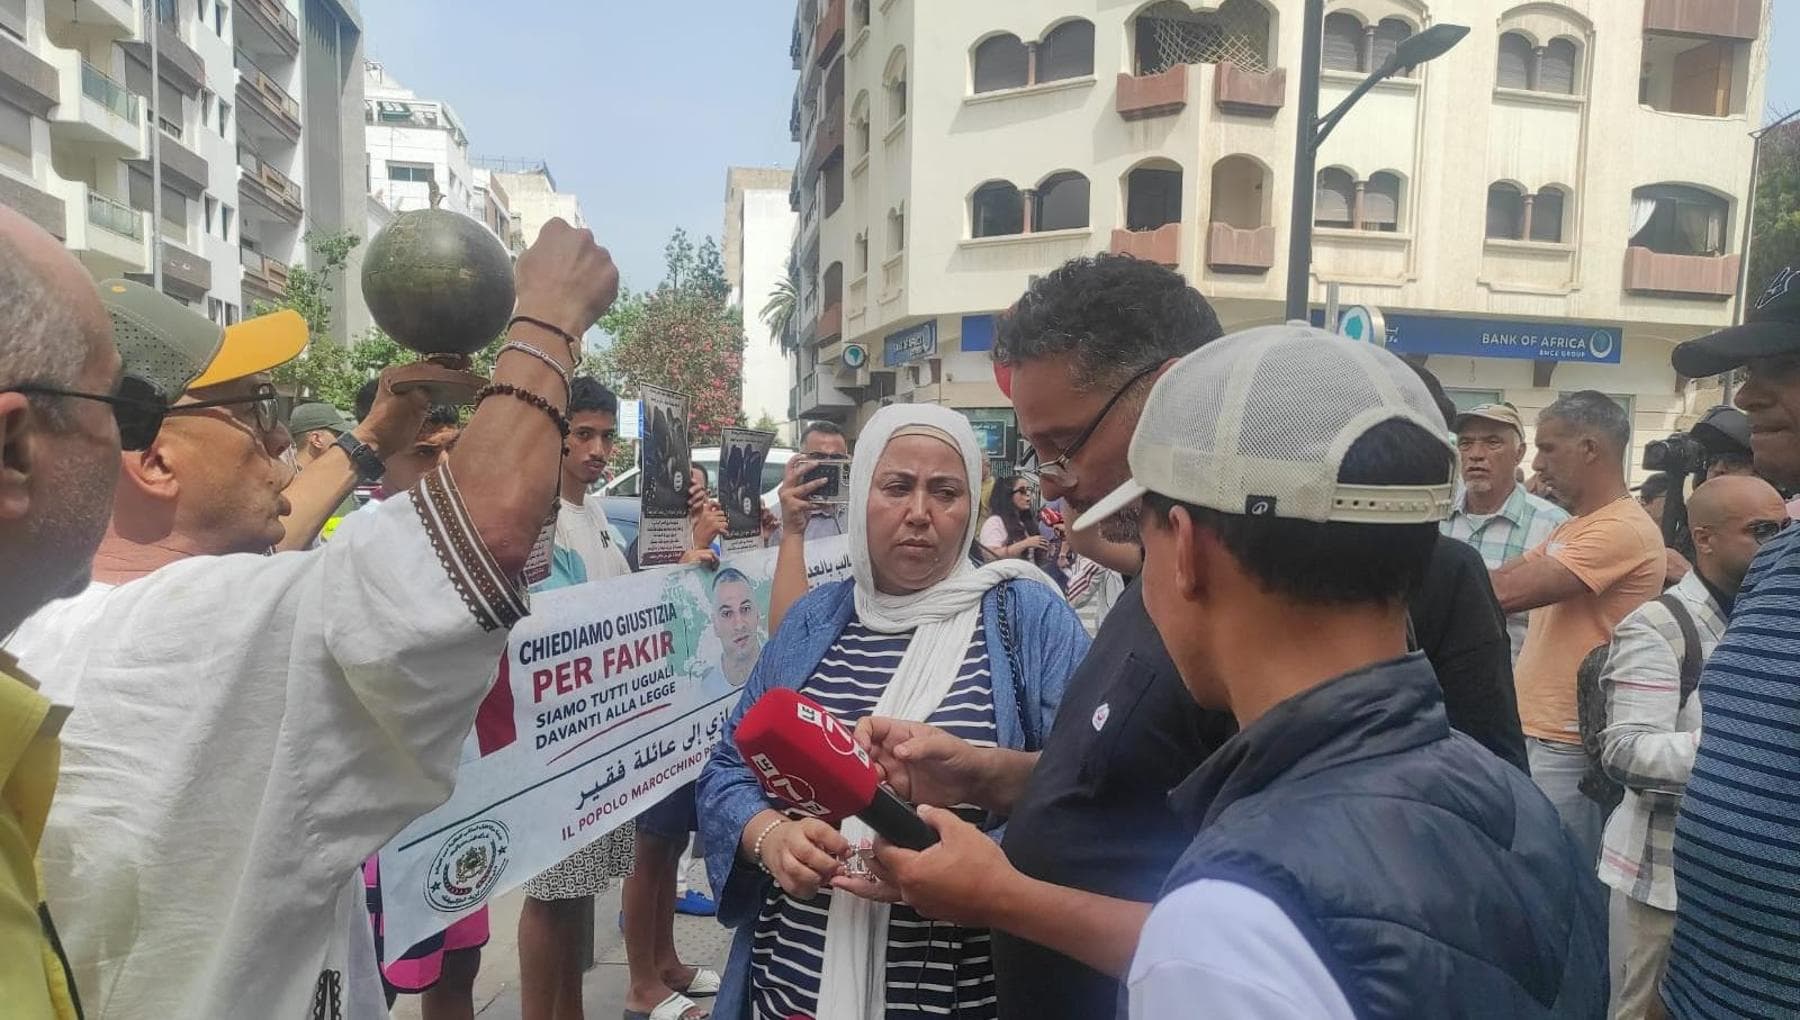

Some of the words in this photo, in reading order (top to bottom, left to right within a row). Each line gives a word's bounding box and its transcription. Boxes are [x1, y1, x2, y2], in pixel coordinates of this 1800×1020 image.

[1482, 333, 1517, 345] BANK
[1521, 335, 1537, 346] OF
[1540, 337, 1585, 349] AFRICA
[519, 619, 614, 665] CHIEDIAMO
[616, 602, 677, 635] GIUSTIZIA
[532, 656, 594, 704] PER
[602, 630, 676, 679] FAKIR
[536, 698, 587, 729] SIAMO
[590, 679, 628, 708] TUTTI
[632, 664, 675, 692] UGUALI
[535, 712, 601, 750] DAVANTI
[605, 698, 637, 722] ALLA
[640, 682, 676, 706] LEGGE
[682, 720, 702, 751] إلى
[575, 760, 626, 811] فقير
[633, 739, 676, 770] عائلة
[562, 827, 575, 841] IL
[578, 793, 627, 831] POPOLO
[631, 752, 701, 800] MAROCCHINO
